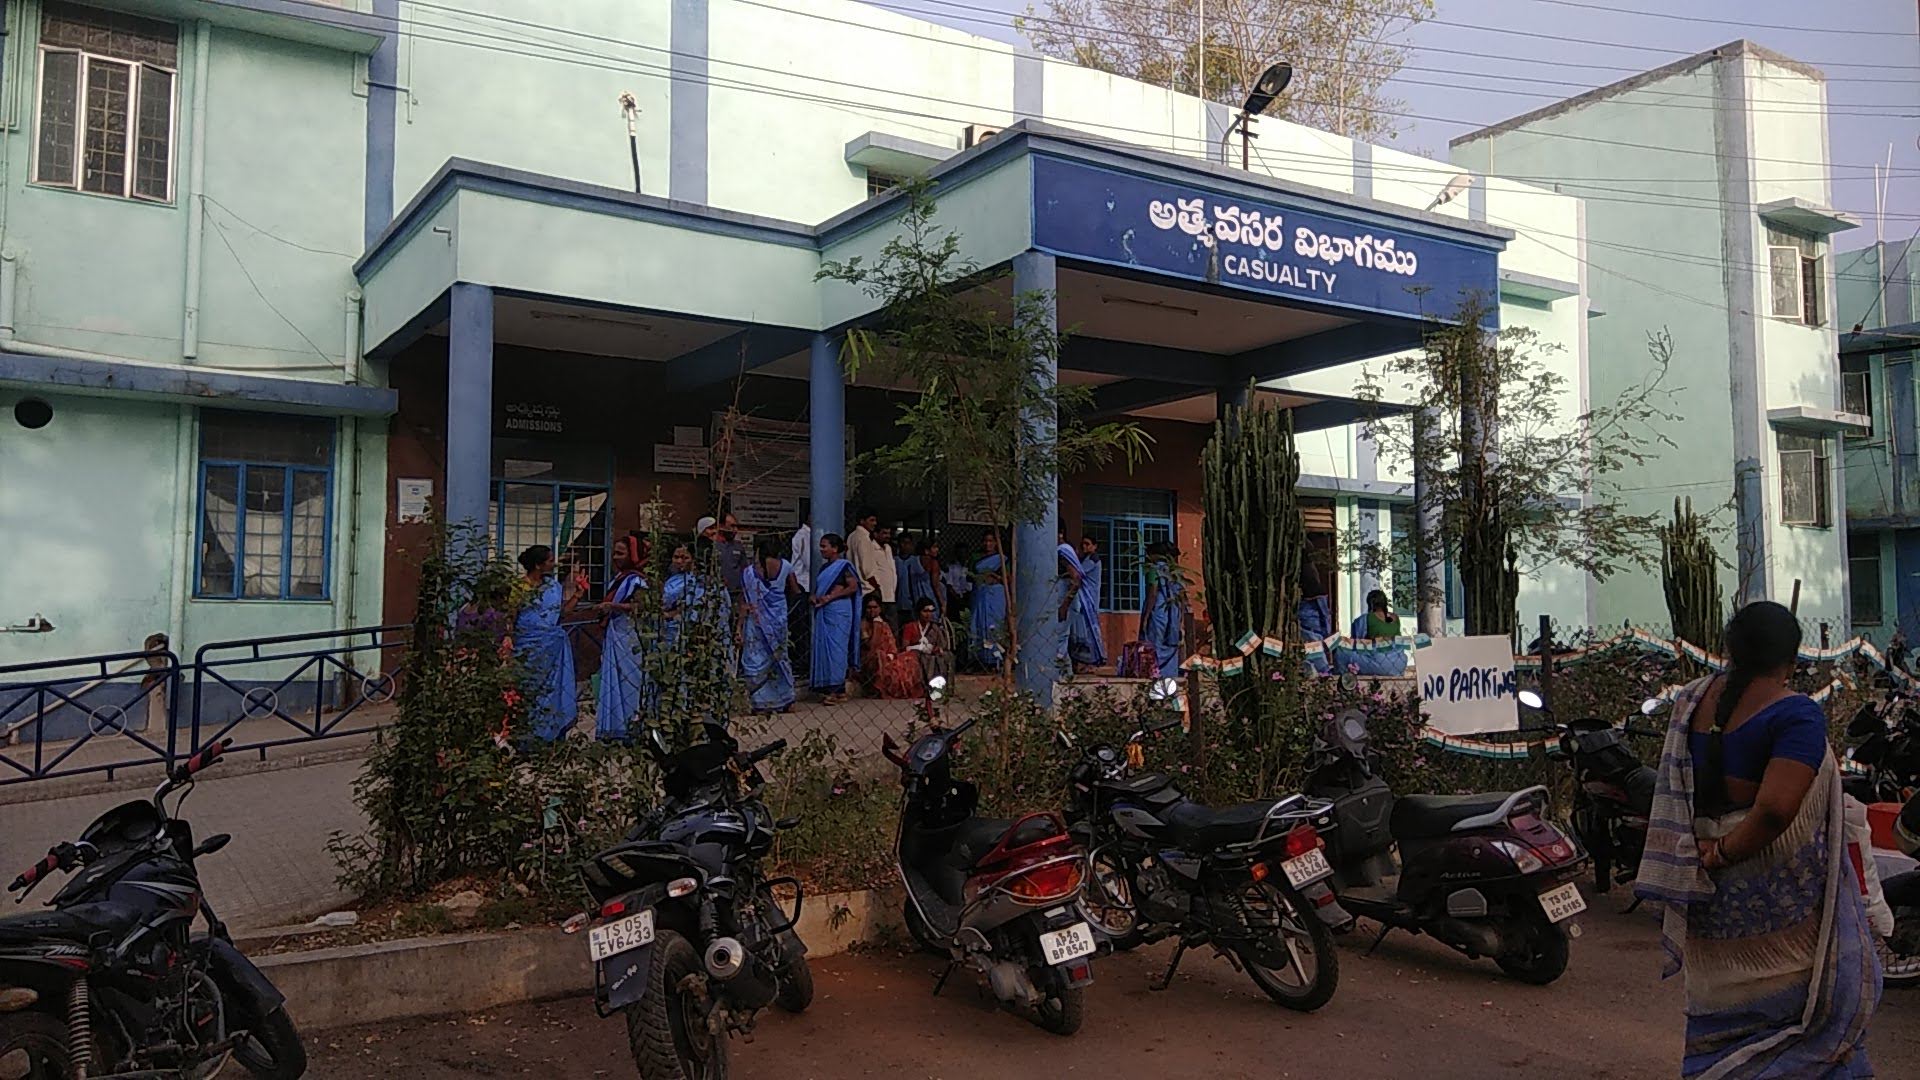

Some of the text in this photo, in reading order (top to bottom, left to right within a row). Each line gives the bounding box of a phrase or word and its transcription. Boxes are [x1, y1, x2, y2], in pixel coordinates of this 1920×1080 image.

[1294, 226, 1418, 276] విభాగము
[1224, 254, 1337, 294] CASUALTY
[505, 418, 563, 432] ADMISSIONS
[1424, 674, 1445, 701] NO
[1291, 851, 1318, 870] TS 05
[1548, 890, 1572, 906] TS 02
[1551, 908, 1563, 918] EC
[604, 916, 642, 940] TS 05
